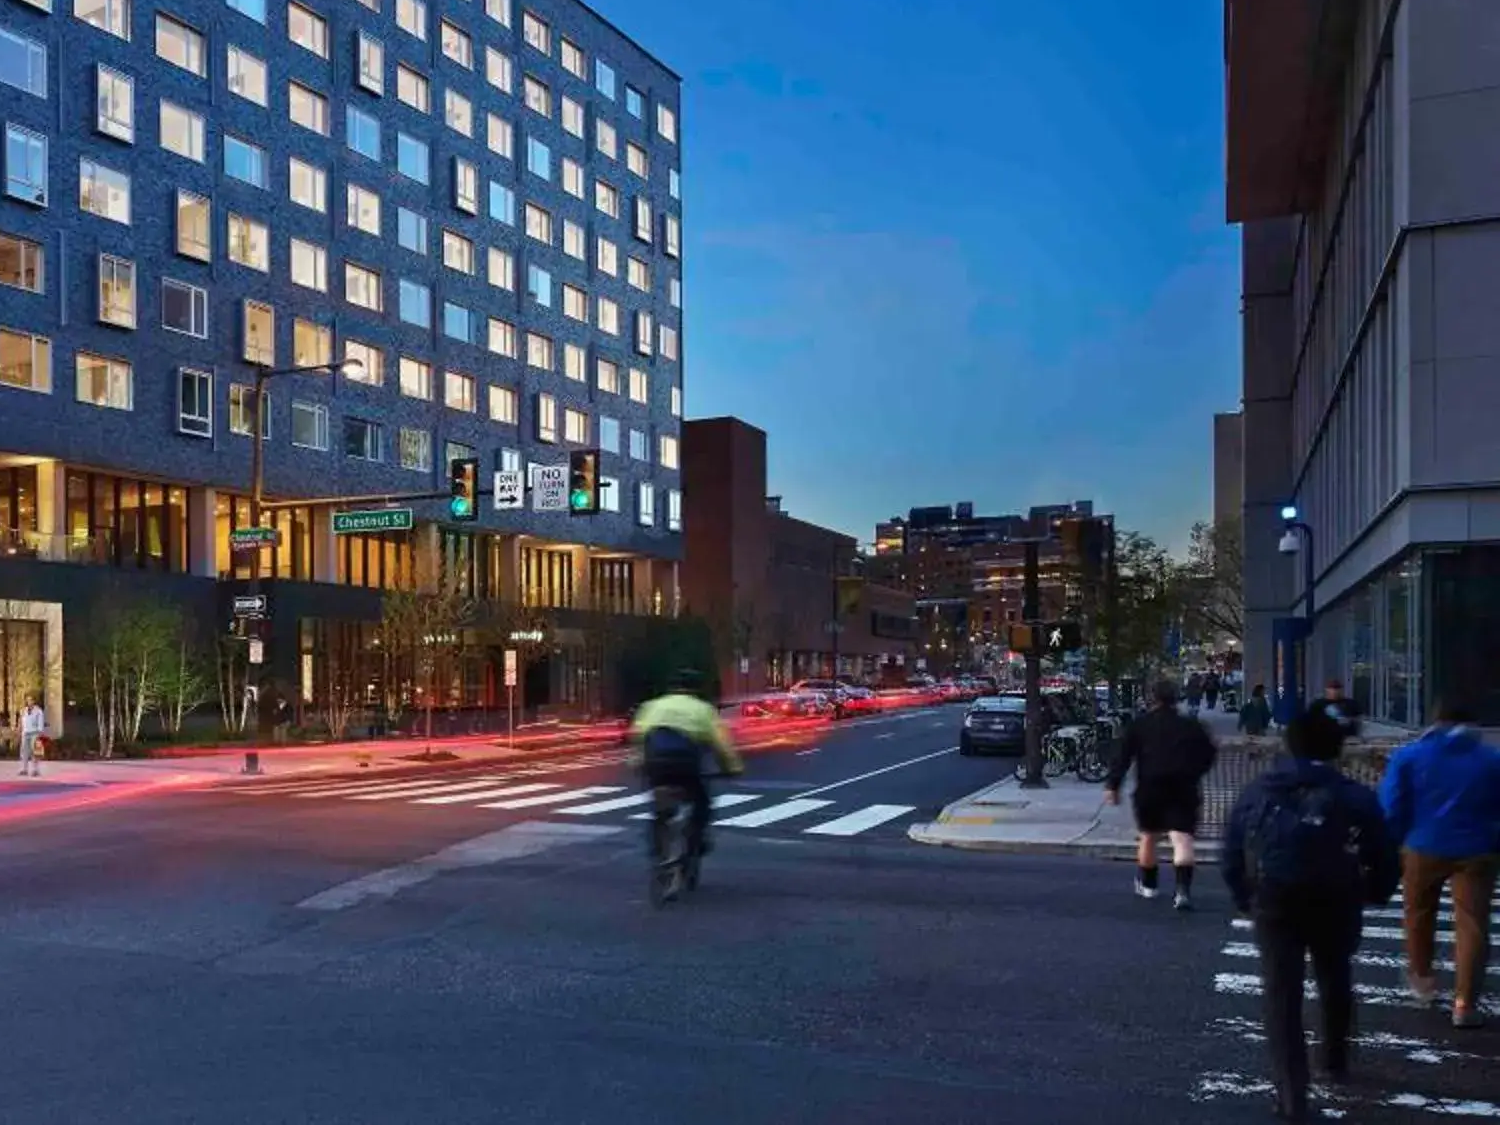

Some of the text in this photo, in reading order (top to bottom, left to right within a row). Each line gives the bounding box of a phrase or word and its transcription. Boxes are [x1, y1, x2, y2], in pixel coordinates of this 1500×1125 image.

[541, 469, 560, 479] NO
[337, 514, 405, 528] Chestnut St
